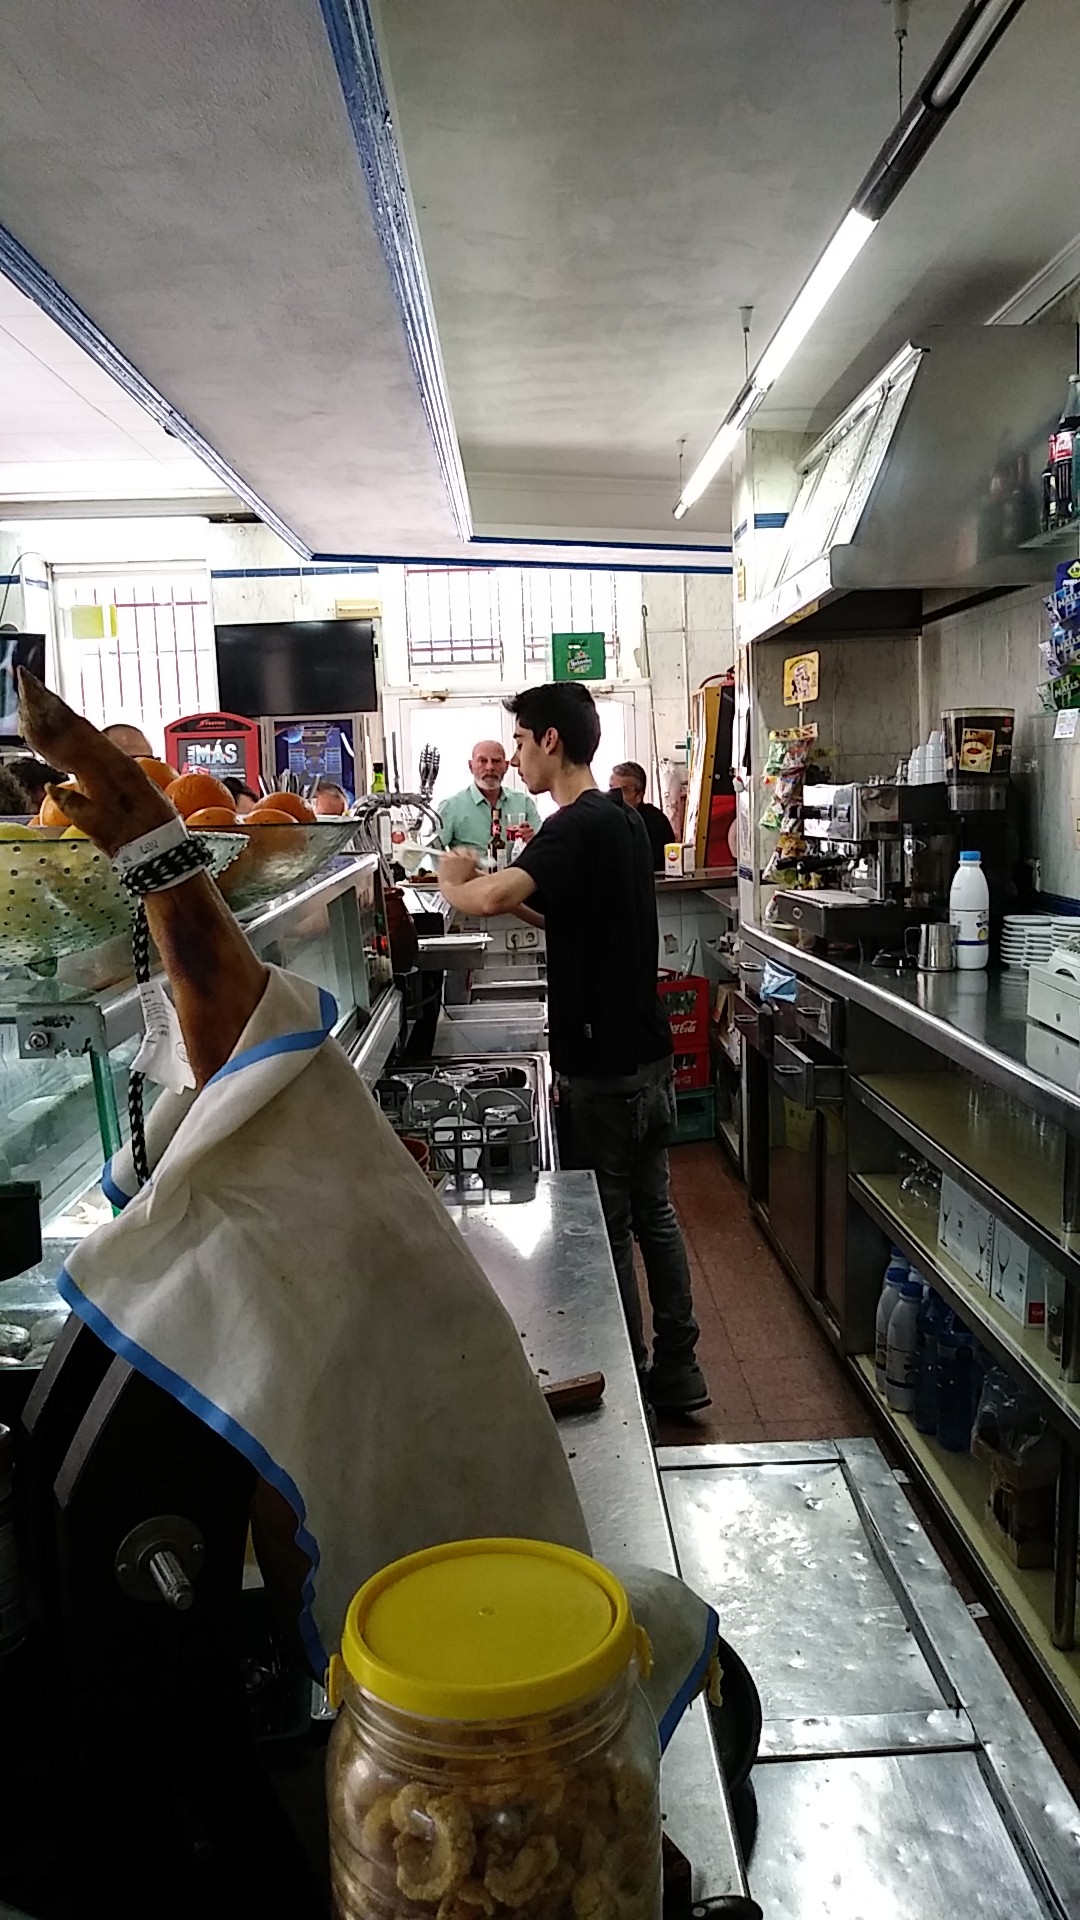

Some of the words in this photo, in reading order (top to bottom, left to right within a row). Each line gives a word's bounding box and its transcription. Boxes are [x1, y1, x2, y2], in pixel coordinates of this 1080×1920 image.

[1057, 634, 1080, 654] HALLS
[1054, 680, 1080, 698] HALLS
[195, 739, 238, 764] MÁS
